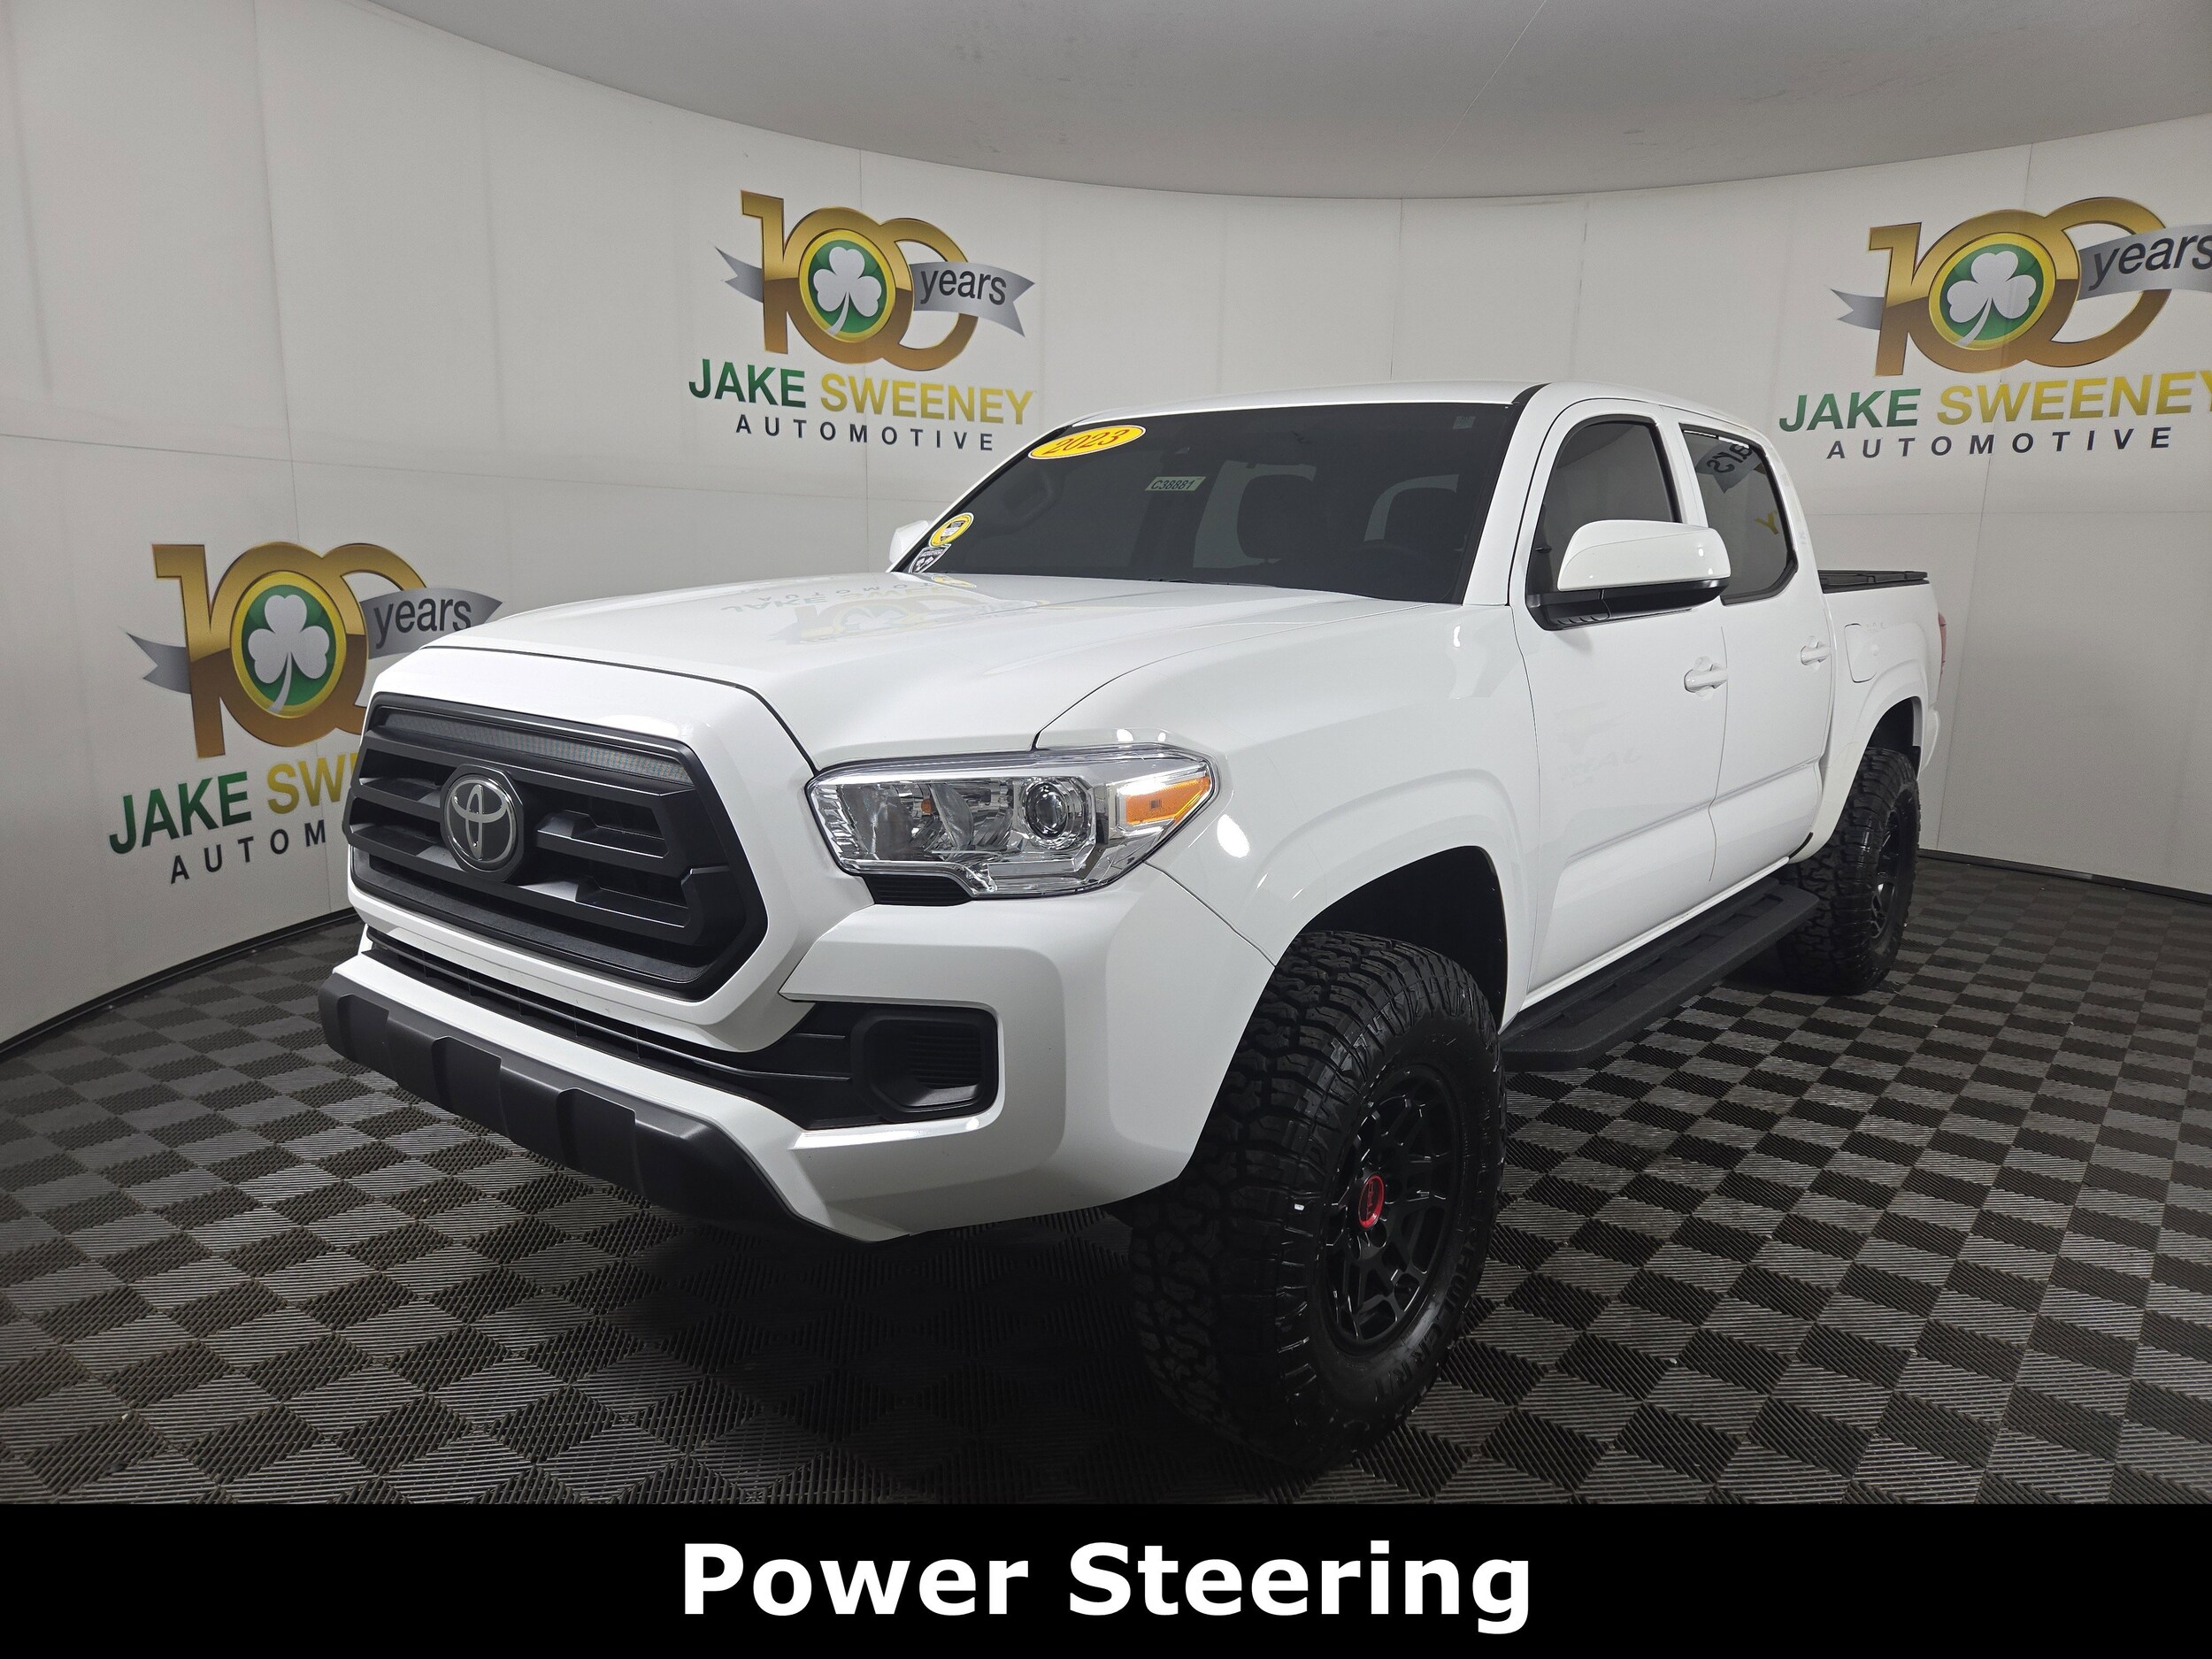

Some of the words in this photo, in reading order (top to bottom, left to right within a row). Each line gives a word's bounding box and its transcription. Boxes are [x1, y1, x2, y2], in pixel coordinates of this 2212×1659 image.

[741, 189, 979, 372] 100
[920, 270, 1007, 306] years
[1868, 196, 2171, 376] 100
[688, 358, 807, 410] JAKE
[819, 373, 1033, 426] SWEENEY
[1778, 388, 1922, 433] JAKE
[735, 413, 993, 451] AUTOMOTIVE
[1041, 428, 1131, 456] 2023
[1826, 426, 2172, 460] AUTOMOTIVE
[1150, 480, 1196, 491] C38881
[152, 541, 427, 759] 100
[373, 597, 472, 650] years
[109, 771, 252, 855] JAKE
[171, 819, 326, 885] AUTOM
